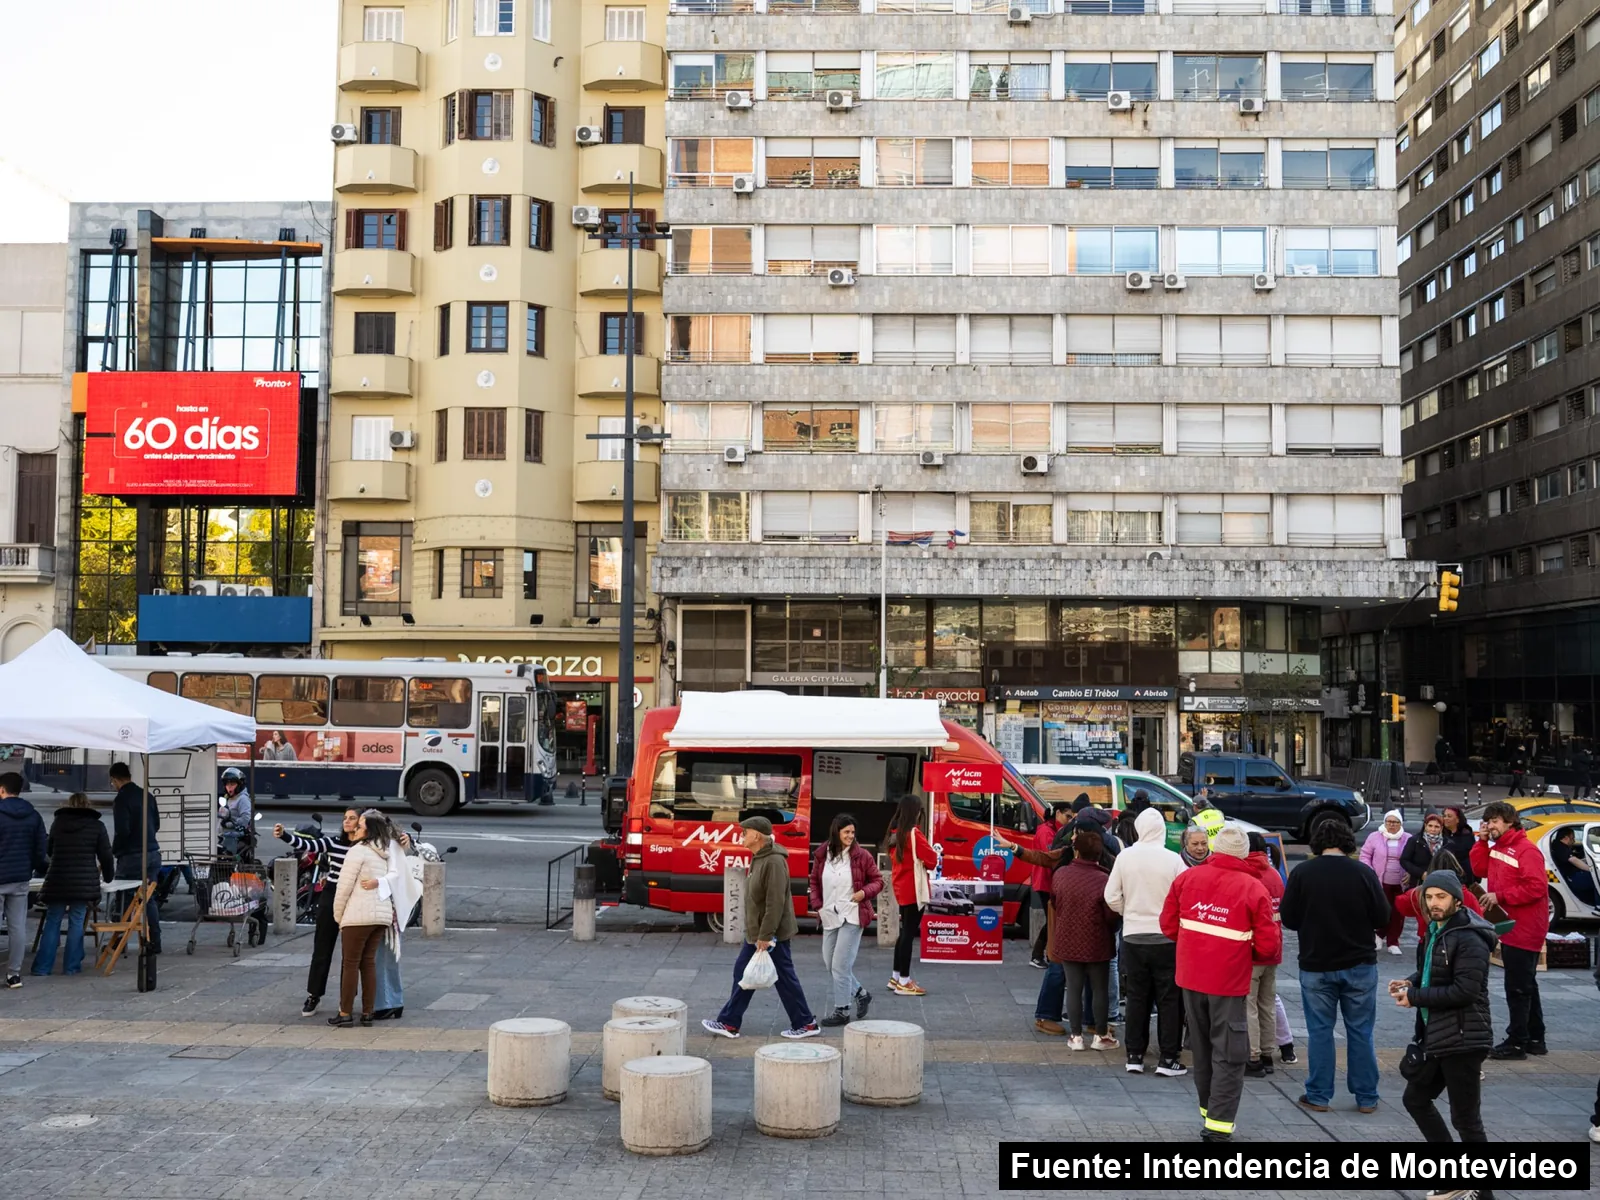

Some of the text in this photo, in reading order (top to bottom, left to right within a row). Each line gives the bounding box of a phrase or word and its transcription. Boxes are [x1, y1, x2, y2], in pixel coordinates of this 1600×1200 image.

[255, 378, 292, 388] Pronto+
[176, 404, 209, 413] hasta en
[123, 416, 260, 450] 60 días
[162, 452, 173, 460] del
[173, 452, 195, 461] primer
[195, 452, 236, 460] vencimiento
[772, 674, 855, 683] GALERIA CITY HALL
[935, 689, 980, 702] exacta
[1014, 687, 1168, 698] Abitab Cambio El Trébol Abitab
[1047, 703, 1123, 713] Compra y Venta
[362, 742, 394, 754] ades
[964, 770, 982, 778] ucm
[961, 779, 982, 787] FALCK
[978, 848, 1009, 857] Afiiate
[724, 855, 750, 868] FAL
[1211, 904, 1230, 915] ucm
[1207, 914, 1228, 923] FALCK
[927, 920, 959, 928] Cuidamos
[937, 928, 955, 936] salud
